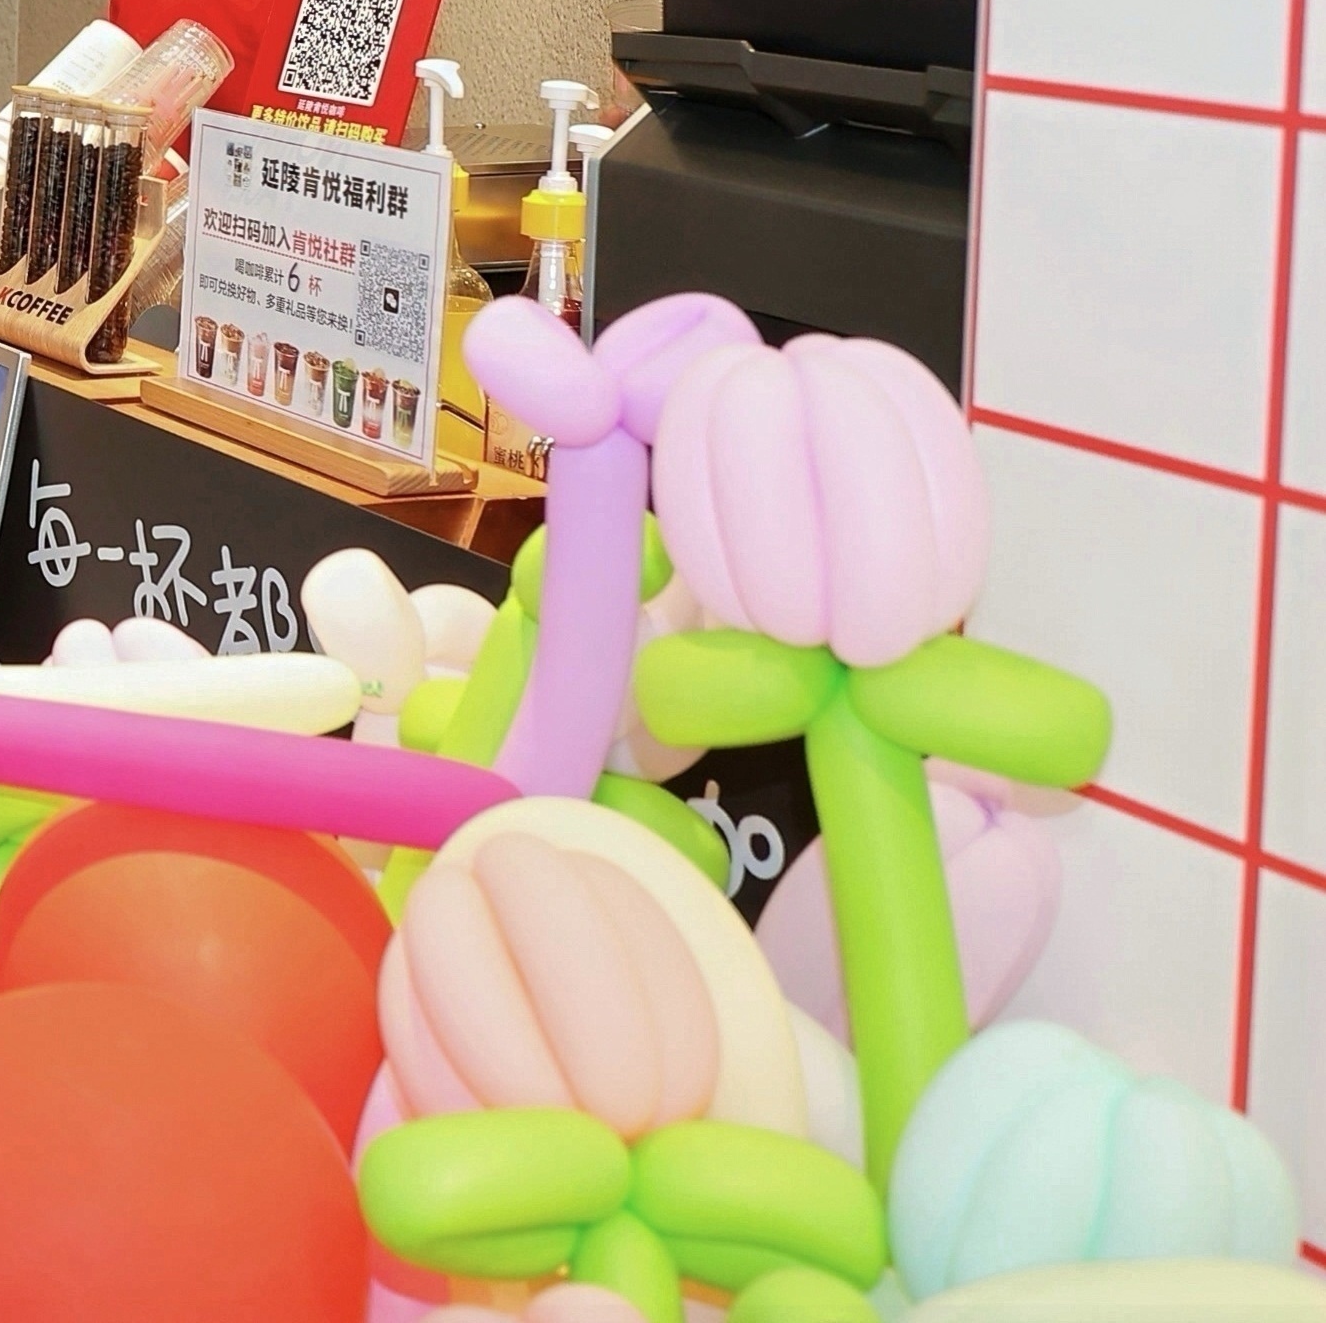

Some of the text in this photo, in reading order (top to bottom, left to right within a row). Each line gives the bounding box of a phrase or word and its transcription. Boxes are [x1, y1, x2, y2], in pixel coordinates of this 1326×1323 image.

[251, 104, 389, 146] 更多特价饮品 请扫码购买
[261, 156, 409, 220] 延陵肯悦福利群
[202, 207, 357, 269] 欢迎扫码加入肯悦社群
[287, 261, 301, 293] 6
[28, 458, 324, 656] 每一杯都
